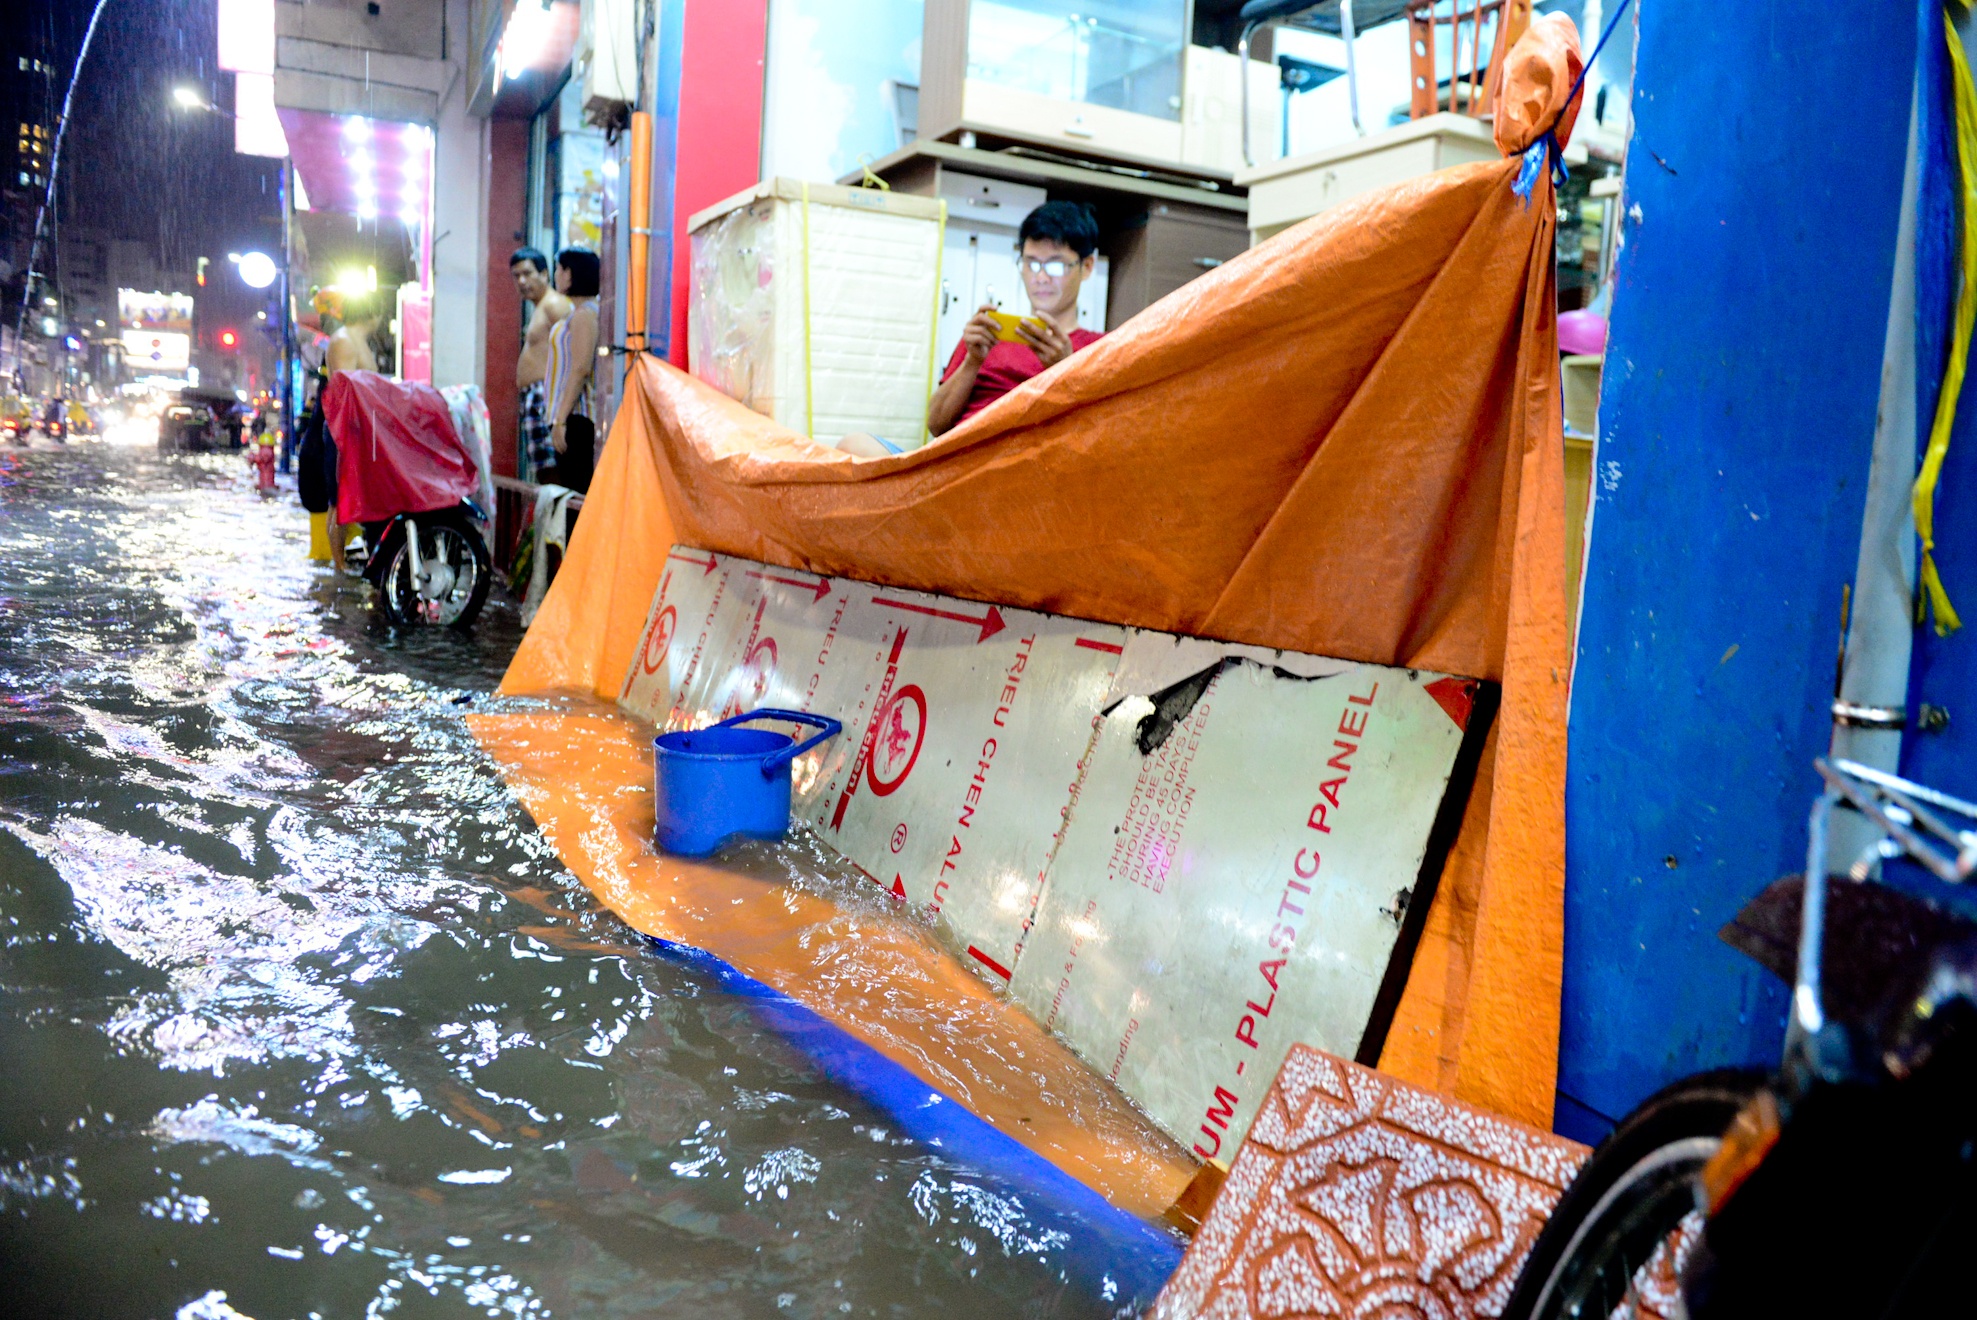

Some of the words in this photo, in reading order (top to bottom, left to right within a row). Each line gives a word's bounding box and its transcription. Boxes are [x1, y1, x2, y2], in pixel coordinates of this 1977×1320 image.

[706, 569, 729, 626] TRIEU
[818, 595, 849, 665] TRIEU
[684, 632, 707, 686] CHEN
[993, 633, 1036, 728] TRIEU
[958, 737, 997, 828] CHEN
[1119, 803, 1149, 878] SHOULD
[1145, 776, 1160, 800] BE
[1130, 812, 1160, 883] DURING
[1156, 787, 1169, 808] 45
[1164, 736, 1187, 783] DAYS
[1141, 820, 1170, 888] HAVING
[1167, 703, 1210, 815] COMPLETED
[1107, 837, 1126, 870] THE
[1153, 787, 1197, 894] EXECUTION
[1235, 847, 1321, 1049] PLASTIC
[1307, 682, 1379, 834] PANEL
